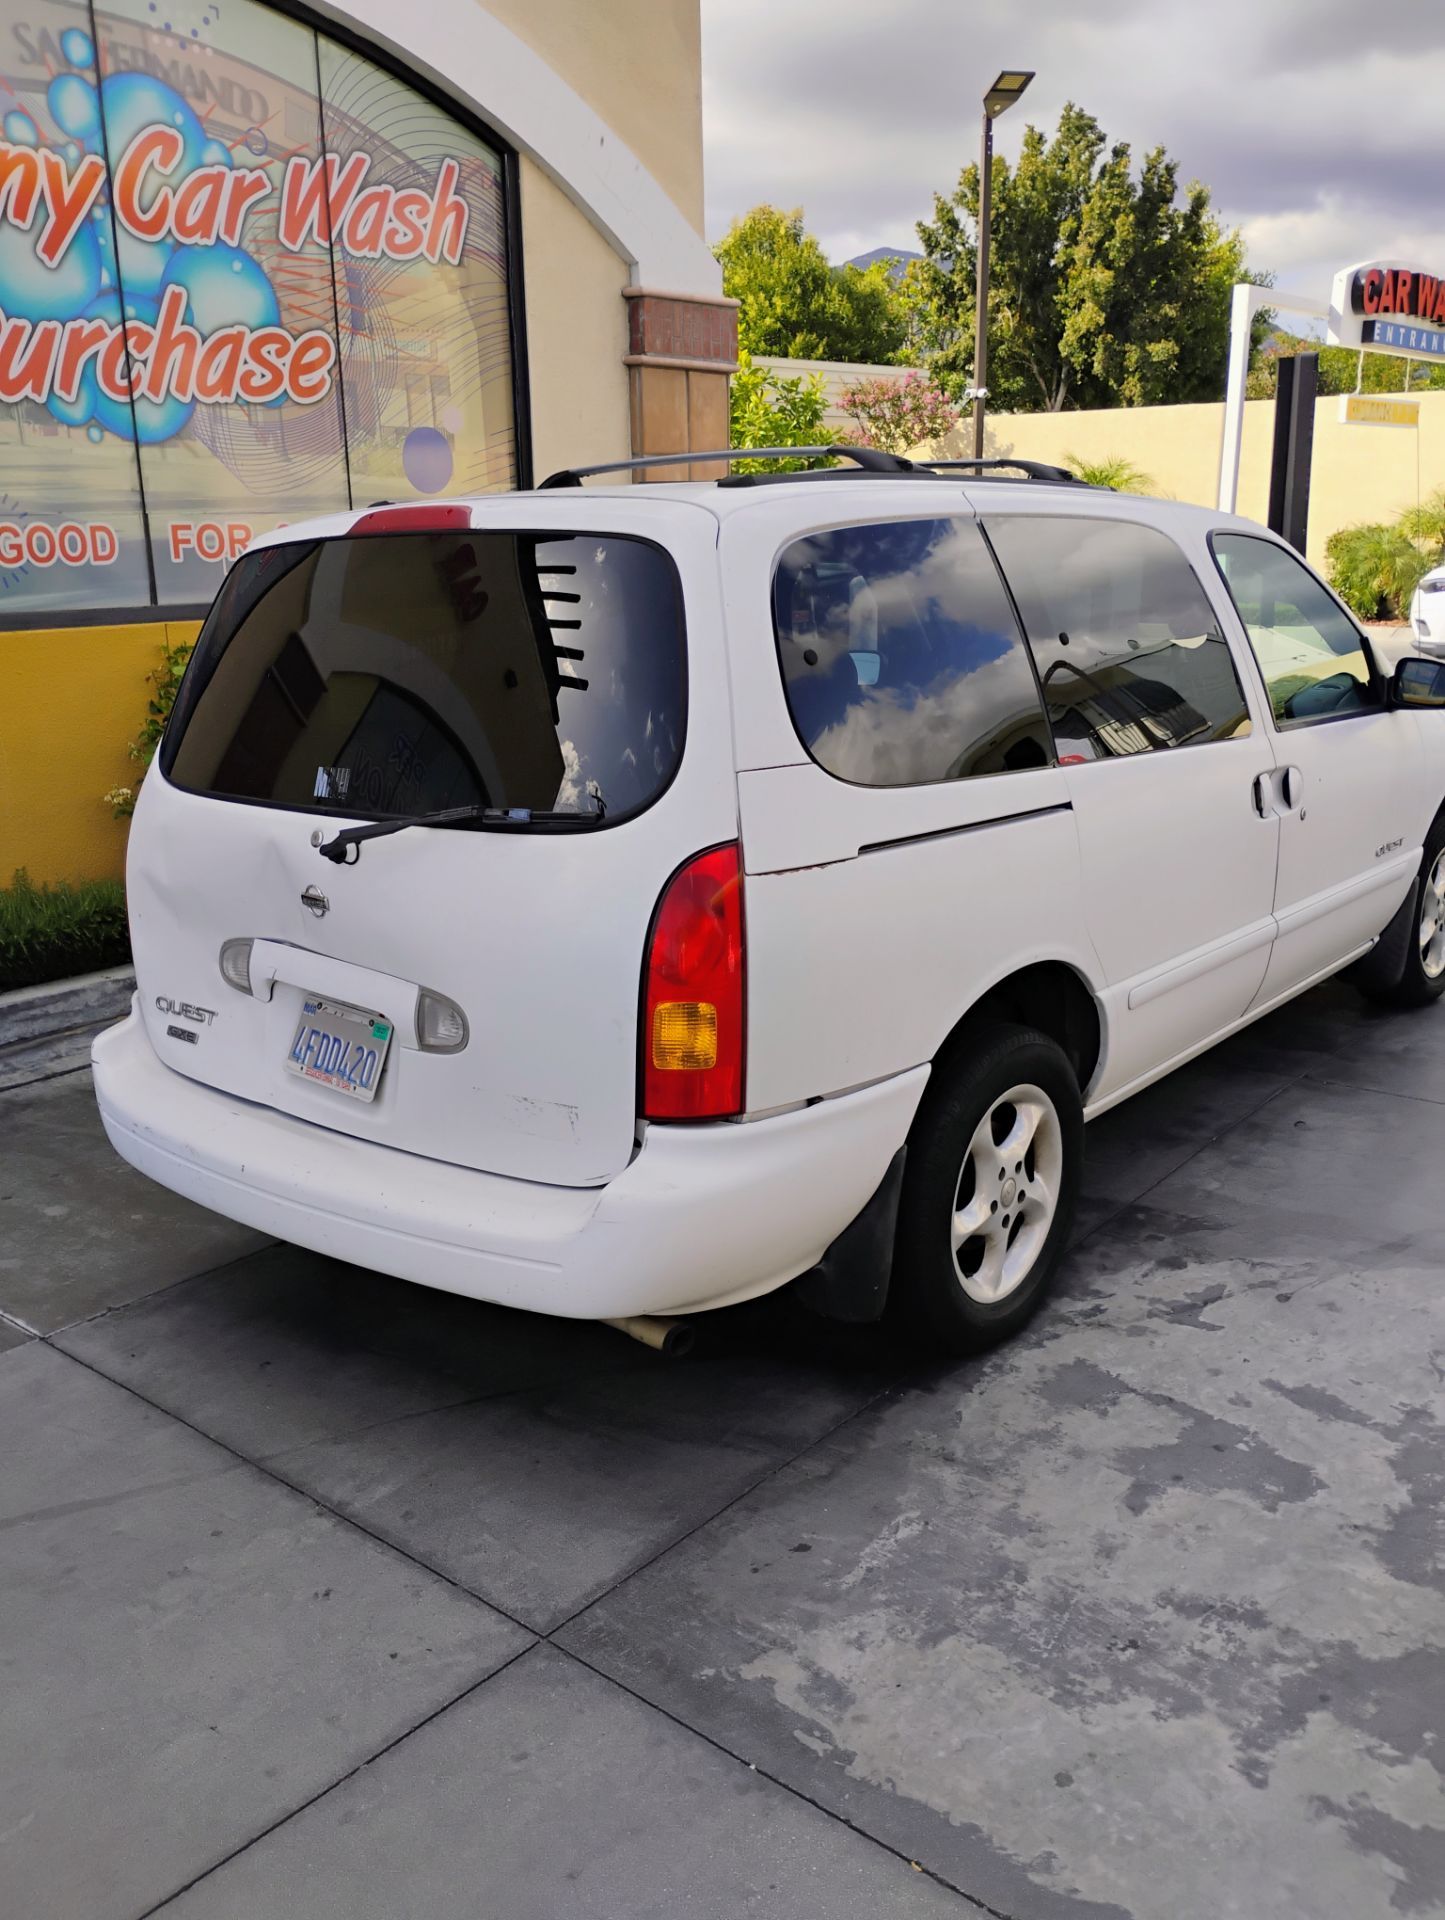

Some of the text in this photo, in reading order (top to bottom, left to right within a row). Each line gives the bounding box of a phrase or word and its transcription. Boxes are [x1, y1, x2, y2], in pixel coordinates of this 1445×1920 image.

[113, 123, 271, 247] Car
[278, 151, 469, 266] Wash
[1363, 268, 1411, 315] CAR
[0, 284, 336, 405] urchase
[1373, 321, 1445, 352] ENTRAN
[0, 521, 255, 568] GOOD FOR
[155, 996, 219, 1026] QUEST
[292, 1026, 378, 1089] 4FDD420
